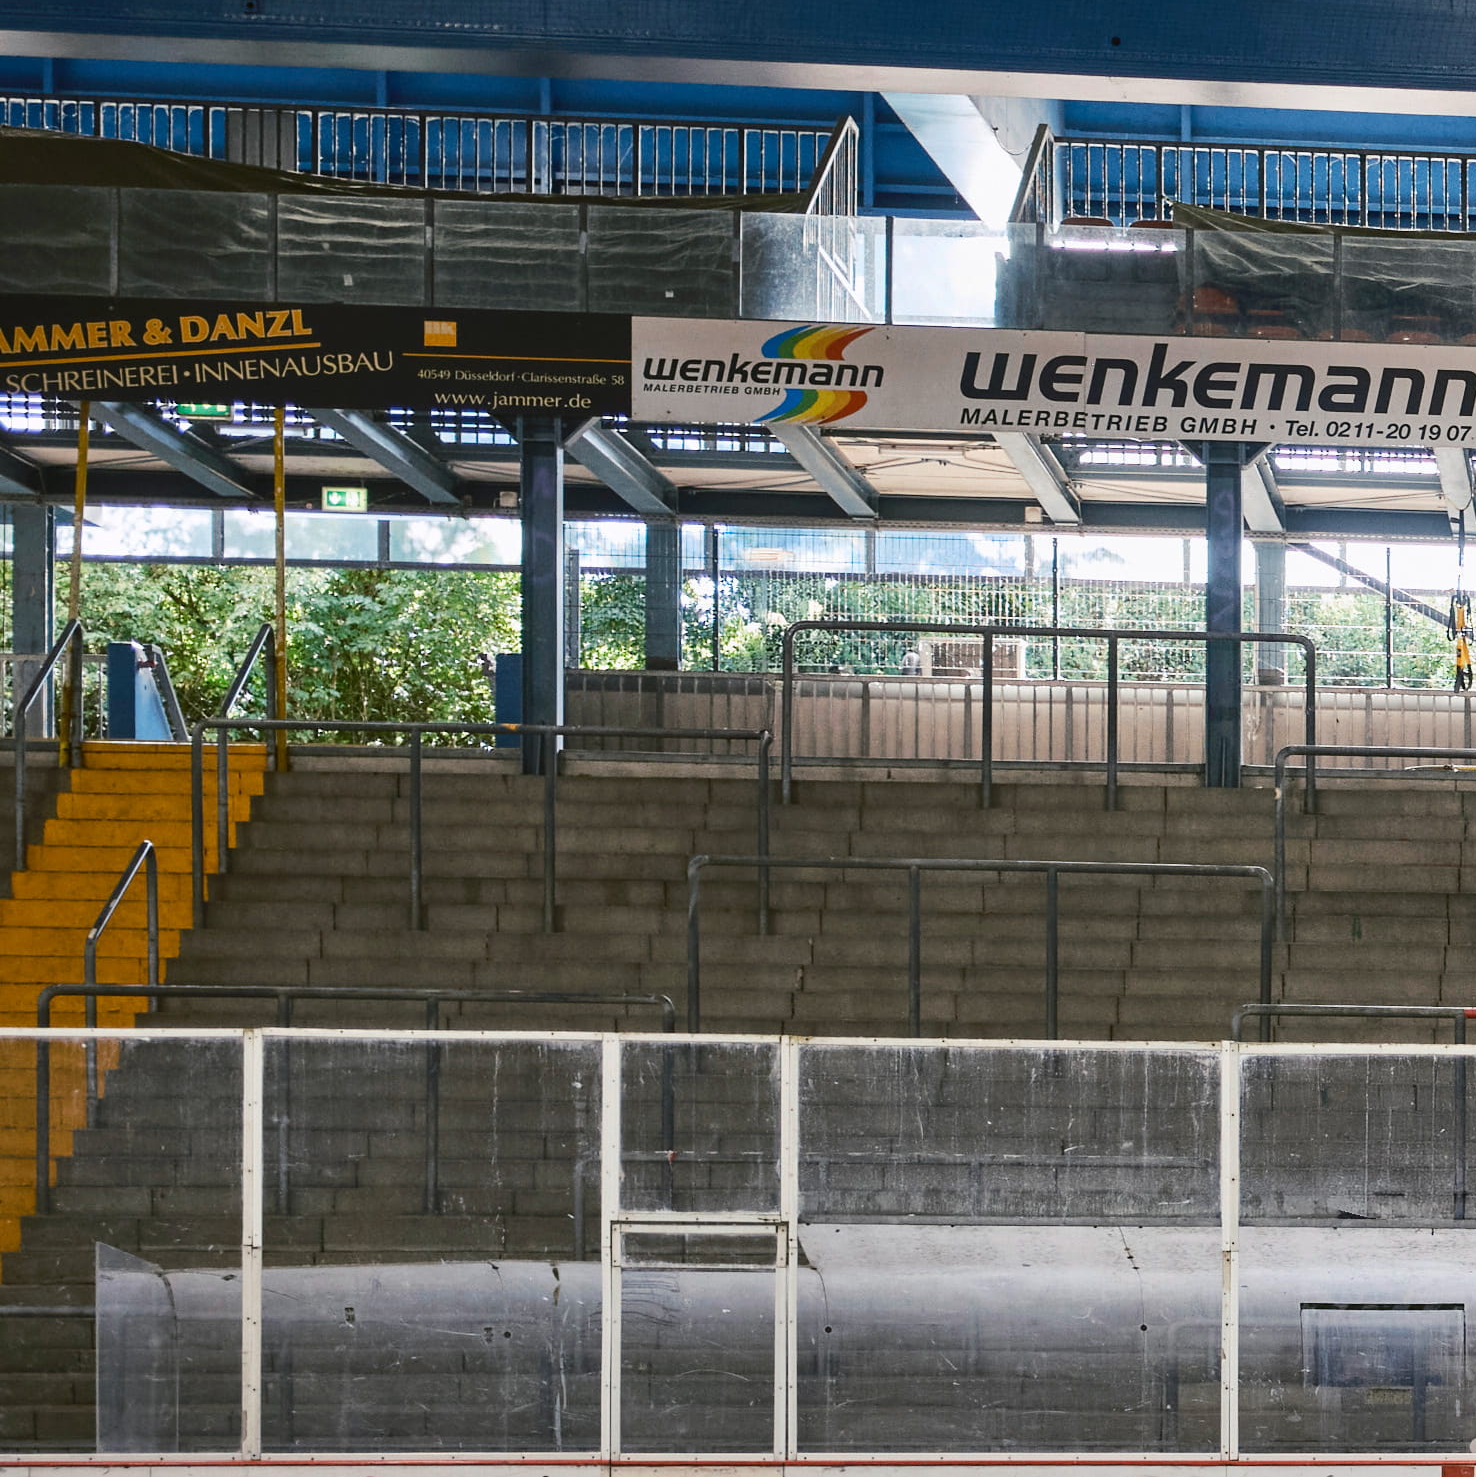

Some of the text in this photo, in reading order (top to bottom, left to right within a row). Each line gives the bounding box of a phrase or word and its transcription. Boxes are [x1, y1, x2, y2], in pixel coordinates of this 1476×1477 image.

[143, 309, 312, 345] & DANZL
[6, 350, 394, 395] SCHREINEREI INNENAUSBAU
[417, 368, 450, 381] 40549
[611, 375, 625, 385] 58
[643, 353, 884, 388] wenkemann
[434, 389, 591, 409] www.jammer.de
[643, 383, 781, 396] MALERBETRIEB GMBH
[959, 407, 1168, 433] MALERBETRIEB
[1180, 416, 1258, 435] GMBH
[1285, 419, 1319, 437] Tel.
[1325, 421, 1411, 440] 0211-20
